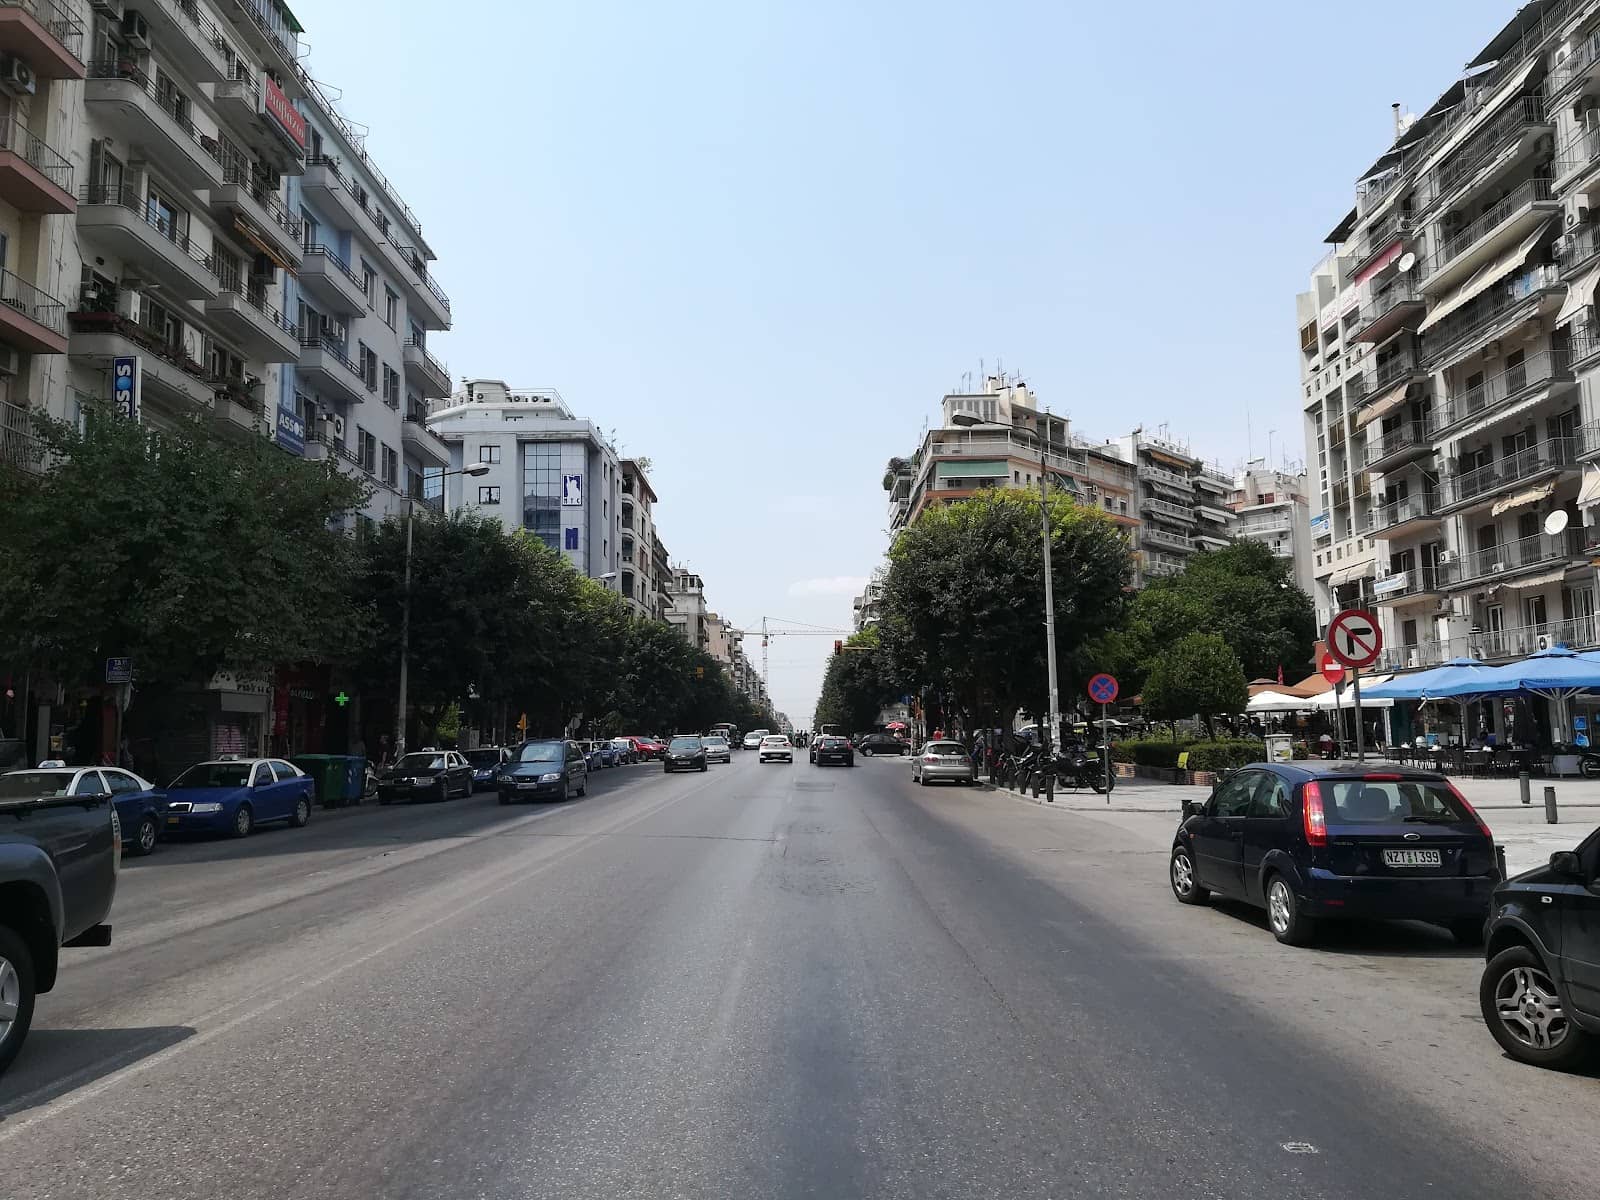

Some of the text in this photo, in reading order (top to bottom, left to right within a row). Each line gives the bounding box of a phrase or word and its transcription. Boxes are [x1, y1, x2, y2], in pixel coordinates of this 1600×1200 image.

[116, 364, 131, 418] SSOS
[278, 412, 304, 438] ASSOS
[1386, 850, 1439, 864] NZT 1399
